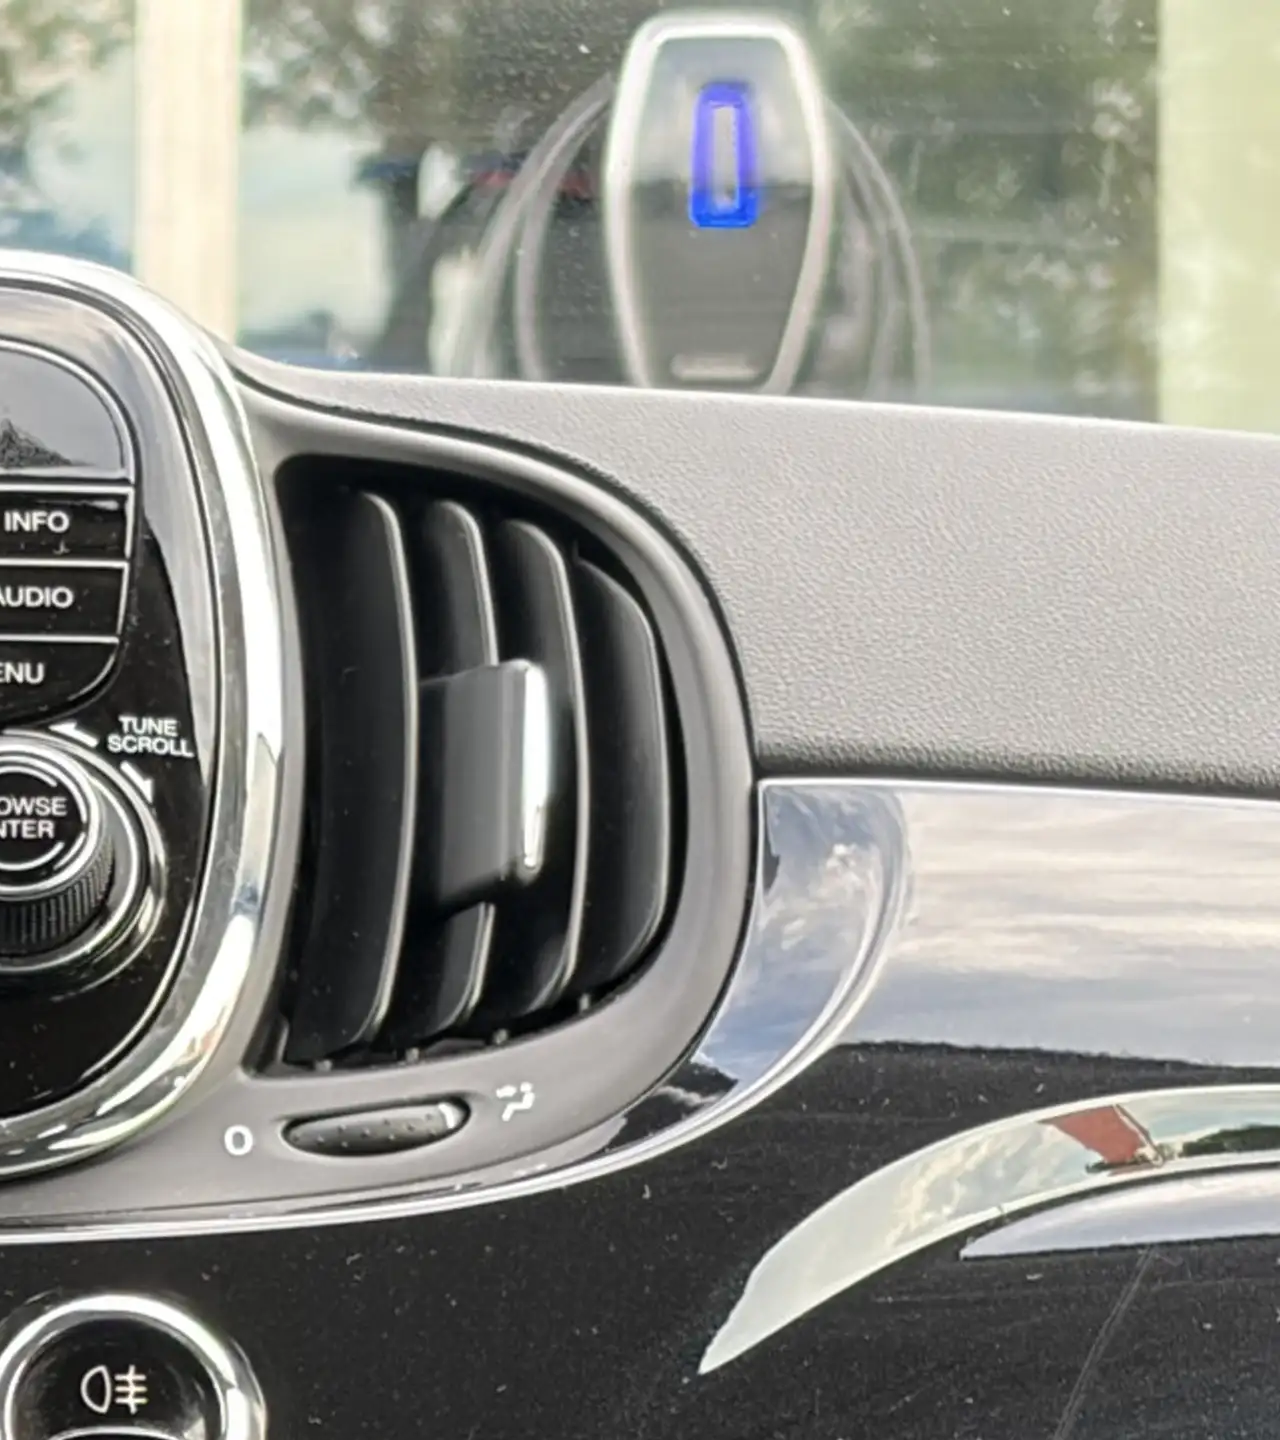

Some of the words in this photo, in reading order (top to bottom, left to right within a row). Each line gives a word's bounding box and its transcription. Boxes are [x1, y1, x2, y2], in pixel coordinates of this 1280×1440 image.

[4, 511, 70, 532] INFO
[118, 715, 178, 738] TUNE
[108, 735, 195, 758] SCROLL
